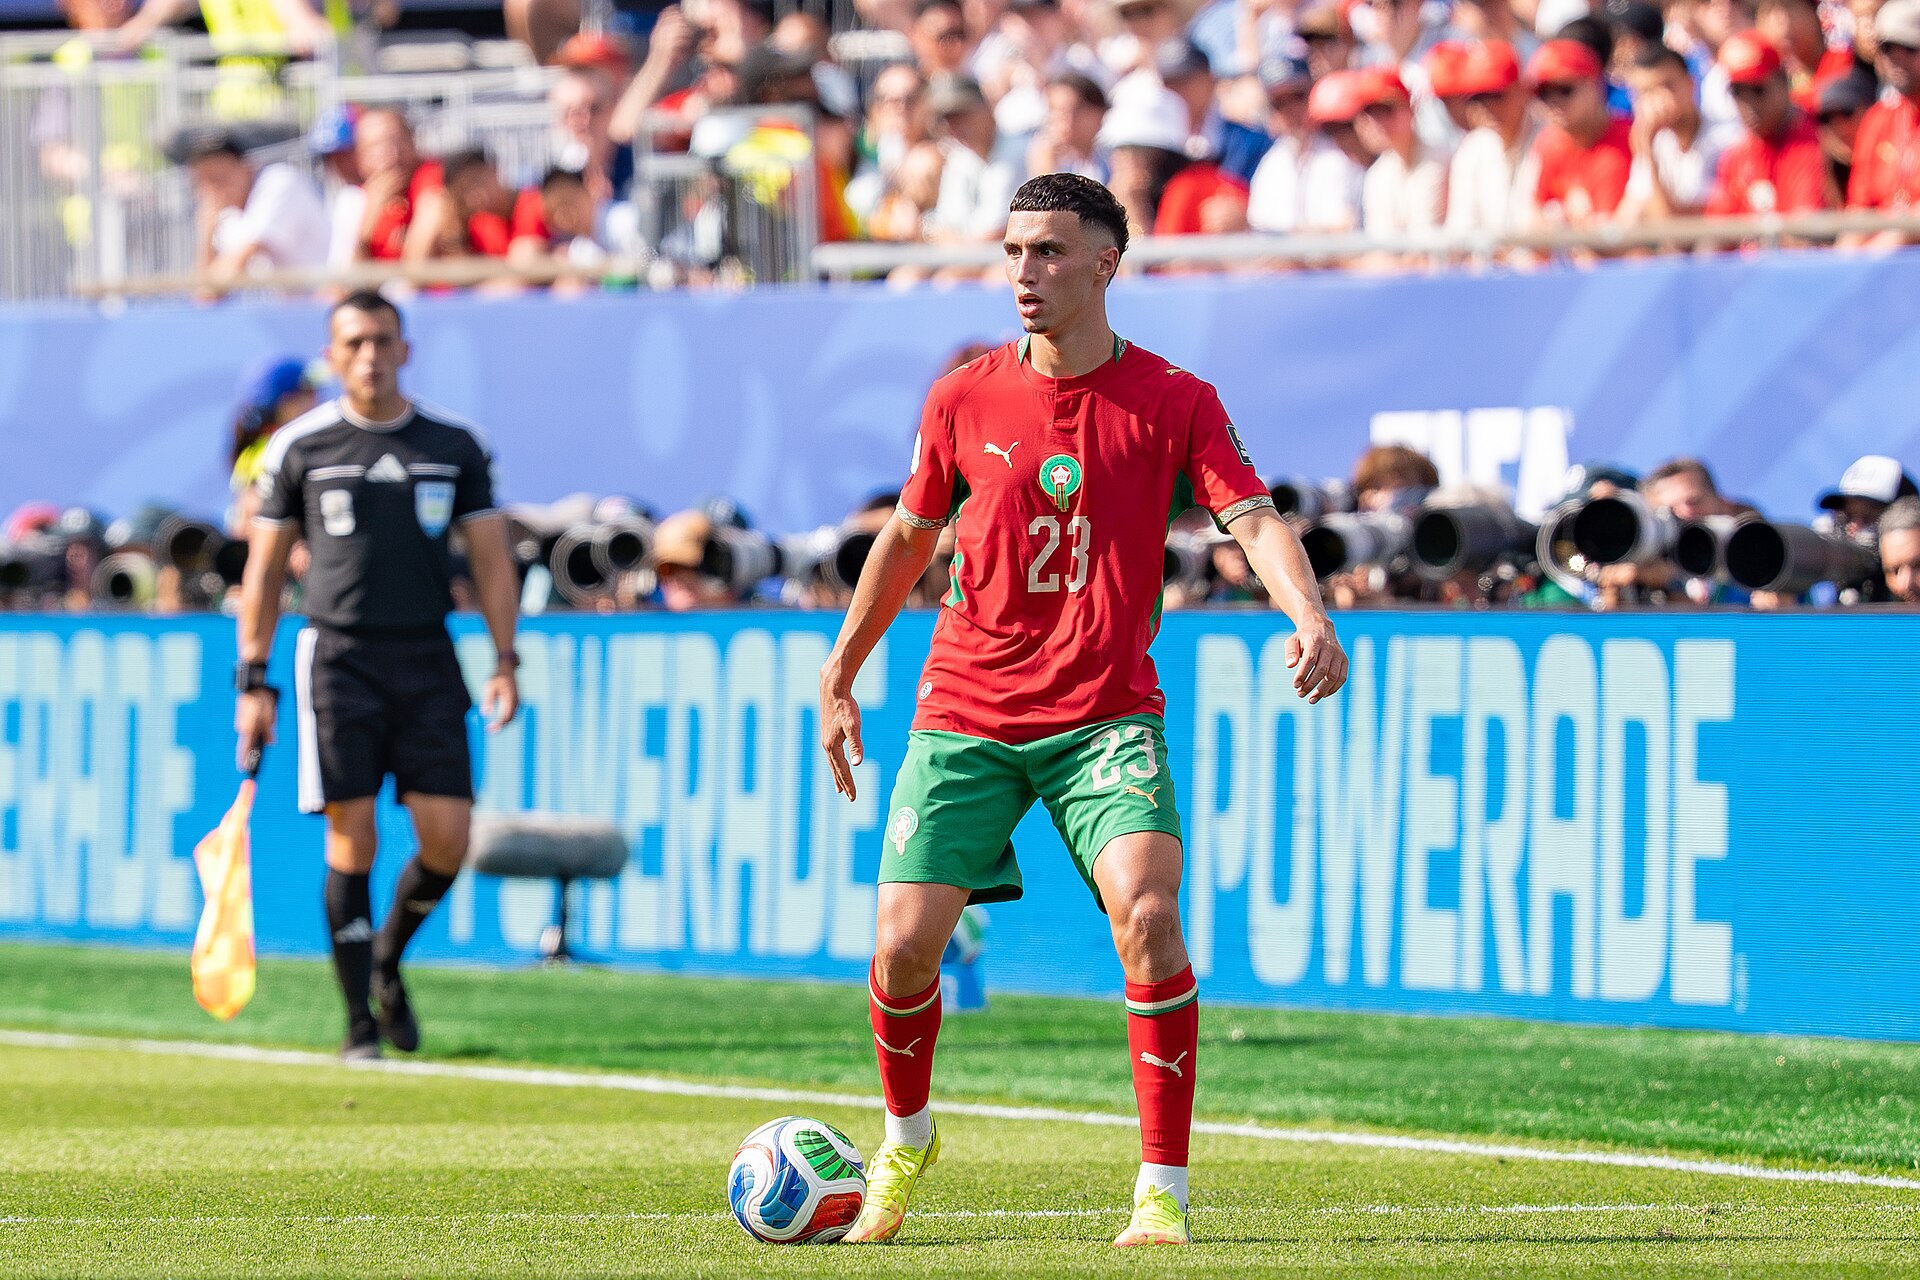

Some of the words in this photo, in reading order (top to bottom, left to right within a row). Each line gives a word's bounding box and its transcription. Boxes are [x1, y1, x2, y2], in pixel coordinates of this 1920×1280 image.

[1028, 515, 1091, 593] 23
[1090, 724, 1158, 792] 23
[1188, 632, 1737, 1005] POWERADE
